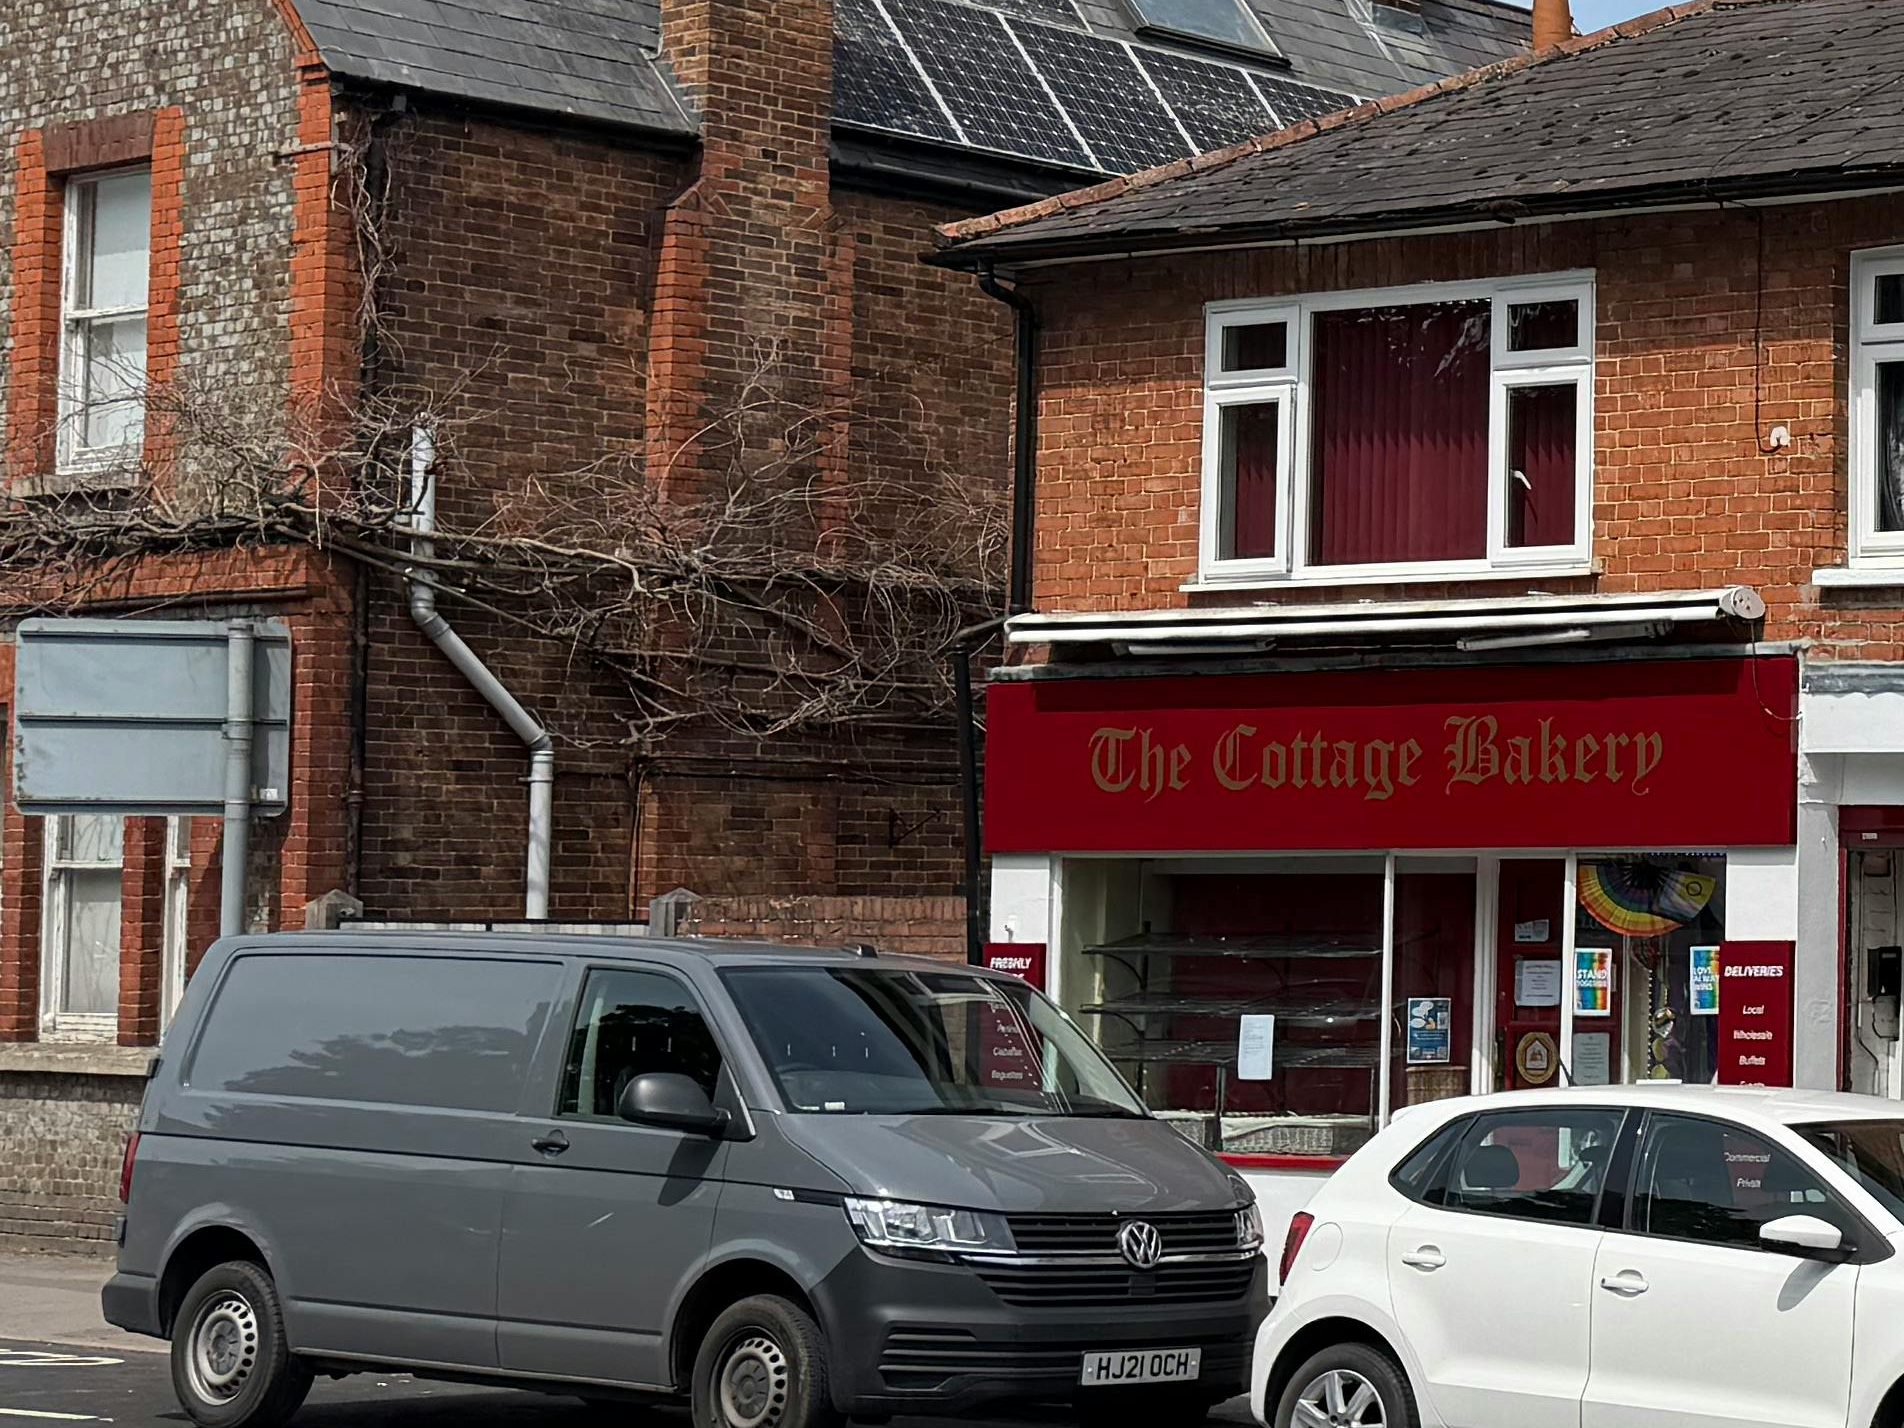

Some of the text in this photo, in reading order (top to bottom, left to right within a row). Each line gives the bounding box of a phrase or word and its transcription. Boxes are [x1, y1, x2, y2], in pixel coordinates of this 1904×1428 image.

[1088, 715, 1663, 804] The Cottage Bakery
[1724, 965, 1784, 977] DELIVERIES
[1742, 1004, 1765, 1016] Local
[1096, 1352, 1190, 1381] HJ21 OCH
